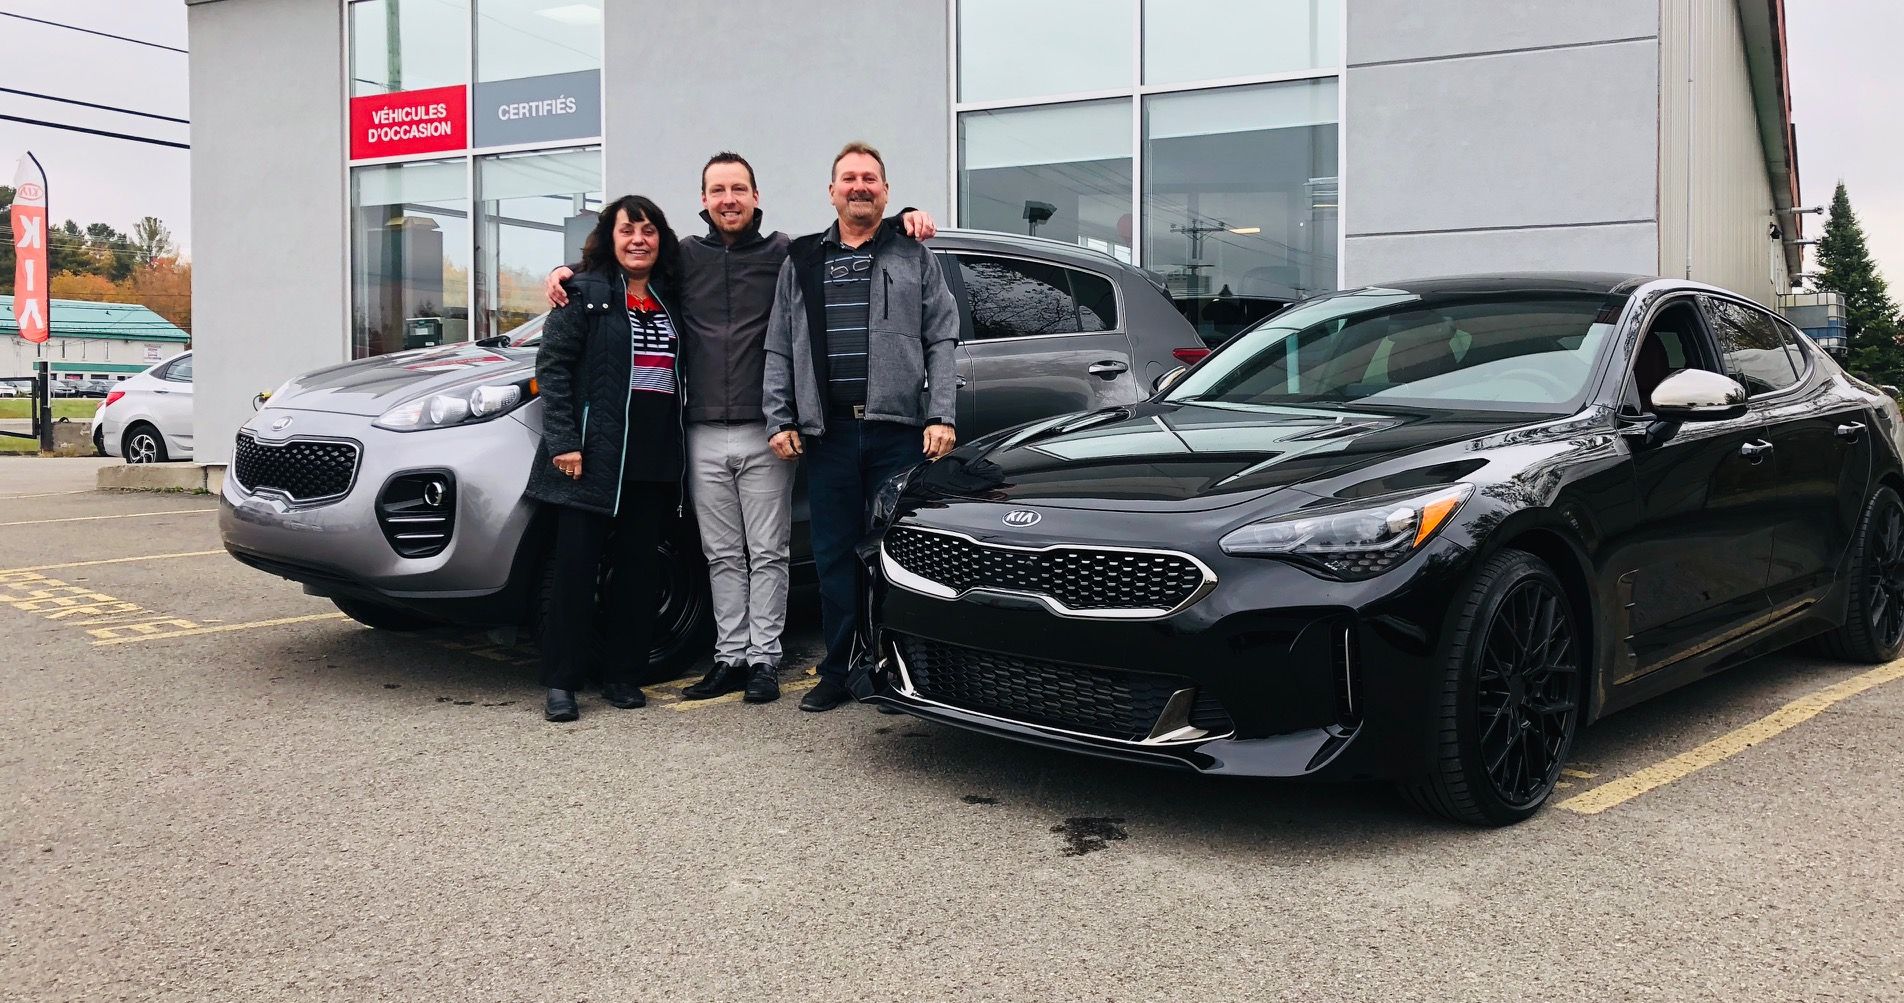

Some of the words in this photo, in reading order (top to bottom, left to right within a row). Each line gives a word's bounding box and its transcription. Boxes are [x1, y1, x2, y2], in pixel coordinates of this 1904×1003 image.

[372, 104, 446, 125] VÉHICULES
[498, 95, 576, 120] CERTIFIÉS
[368, 121, 451, 143] D'OCCASION
[1005, 511, 1034, 523] KIA
